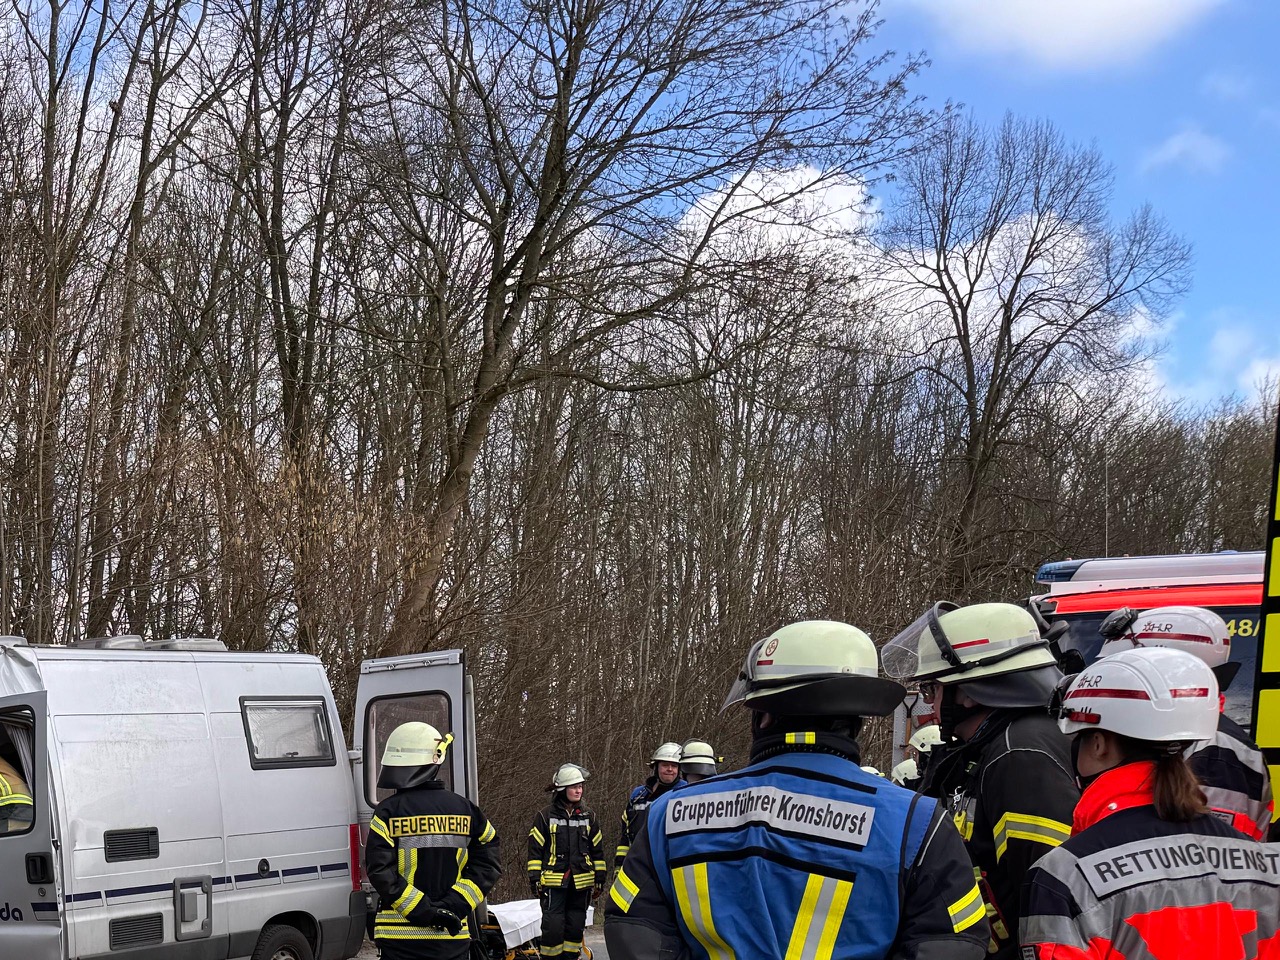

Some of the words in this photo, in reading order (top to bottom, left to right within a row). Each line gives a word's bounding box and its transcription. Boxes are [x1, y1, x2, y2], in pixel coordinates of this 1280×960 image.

[391, 816, 469, 835] FEUERWEHR
[672, 790, 776, 825] Gruppenführer
[776, 794, 868, 836] Kronshorst
